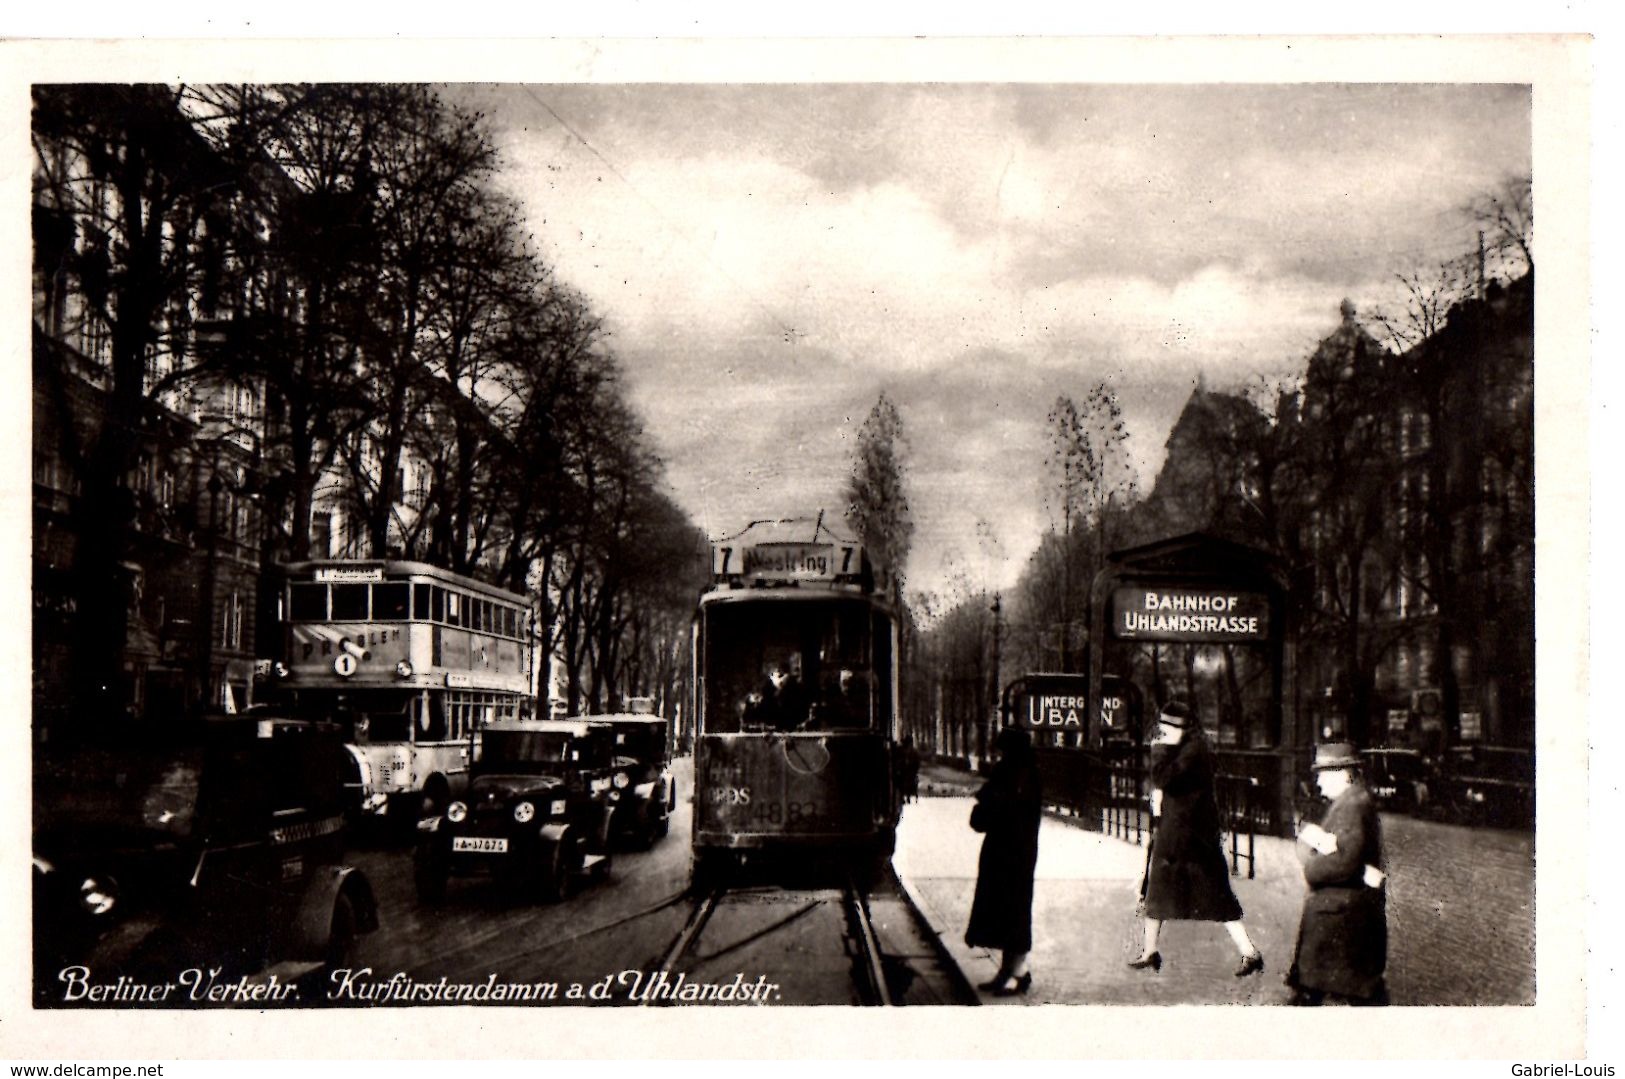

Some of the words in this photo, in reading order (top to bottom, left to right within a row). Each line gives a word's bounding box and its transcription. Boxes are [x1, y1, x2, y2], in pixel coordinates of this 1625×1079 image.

[720, 547, 733, 575] 7
[841, 547, 853, 572] 7
[1145, 592, 1238, 612] BAHNHOF
[1125, 612, 1258, 633] UHLANDSTRASSE
[342, 657, 349, 673] 1
